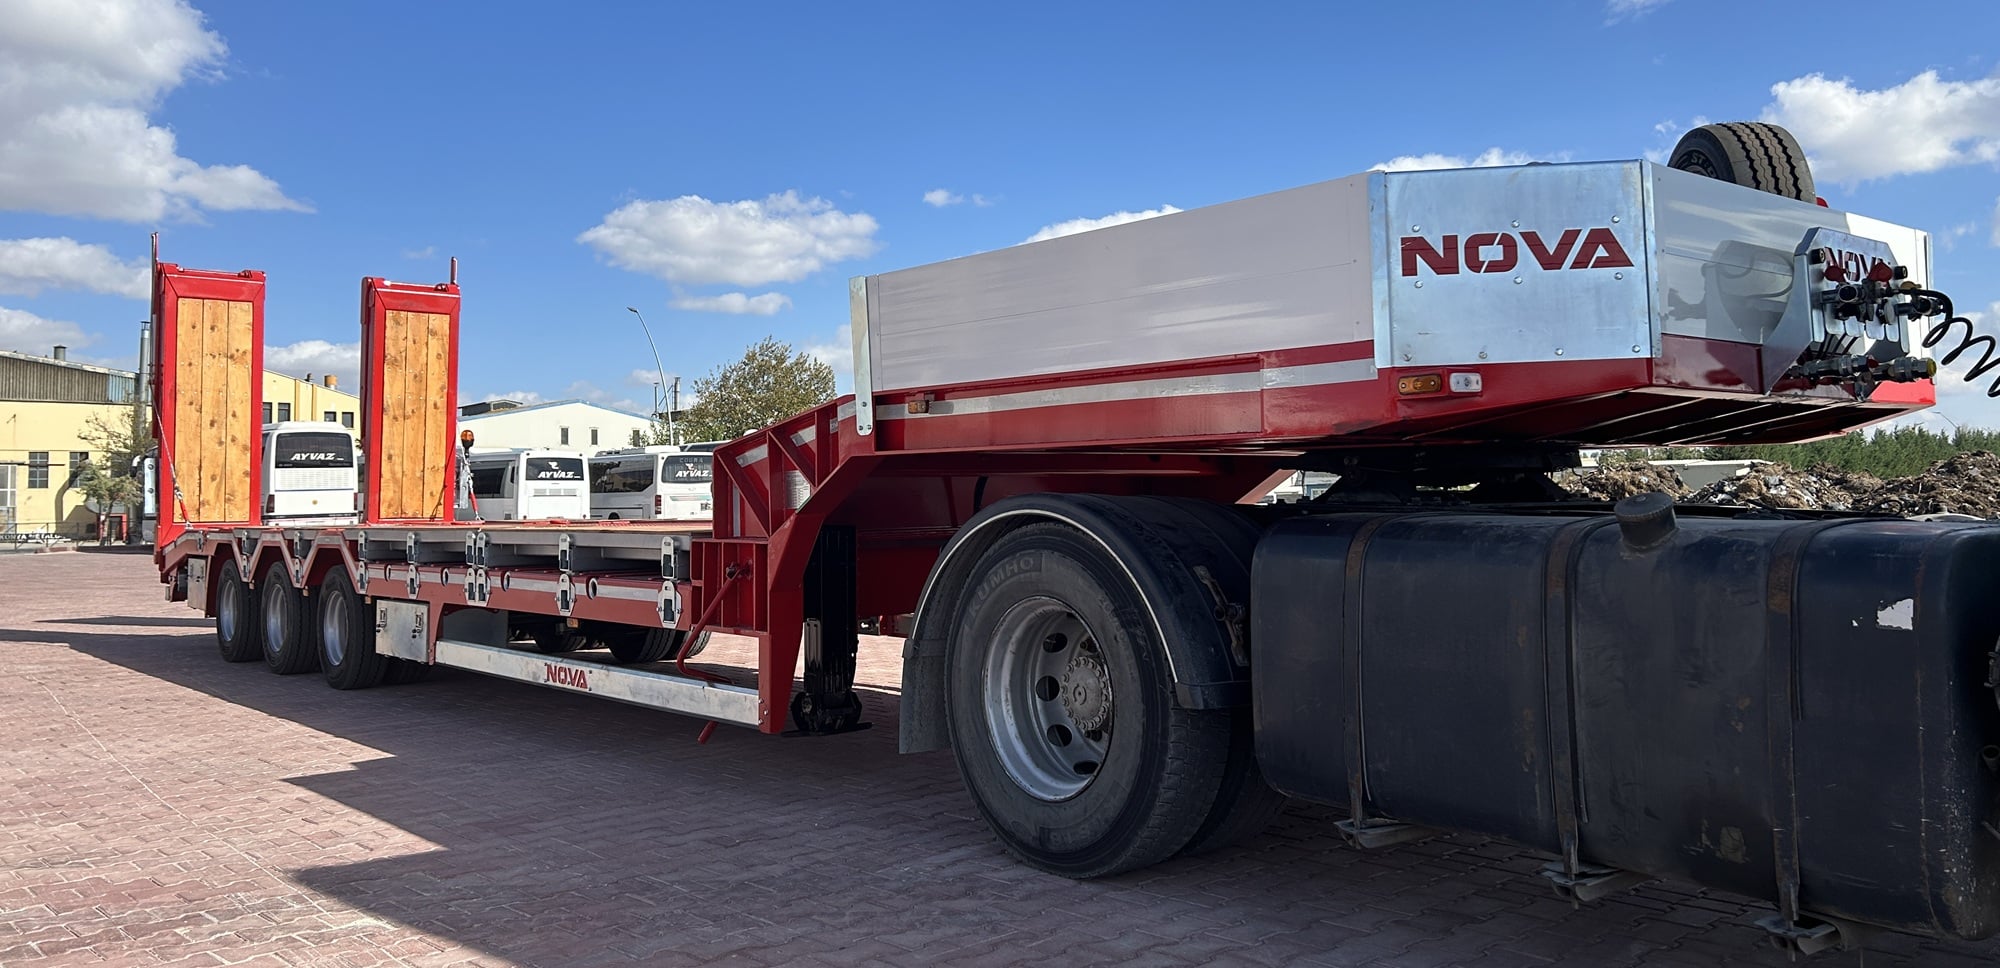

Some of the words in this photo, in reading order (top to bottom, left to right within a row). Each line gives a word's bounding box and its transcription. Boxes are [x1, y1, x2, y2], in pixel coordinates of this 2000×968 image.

[1400, 227, 1635, 277] NOVA
[1824, 246, 1884, 282] NOV
[291, 452, 336, 461] AYVAZ
[537, 470, 574, 479] AYVAZ
[675, 469, 710, 478] AYVAZ
[968, 556, 1034, 618] KUMHO
[546, 664, 588, 689] NOVA
